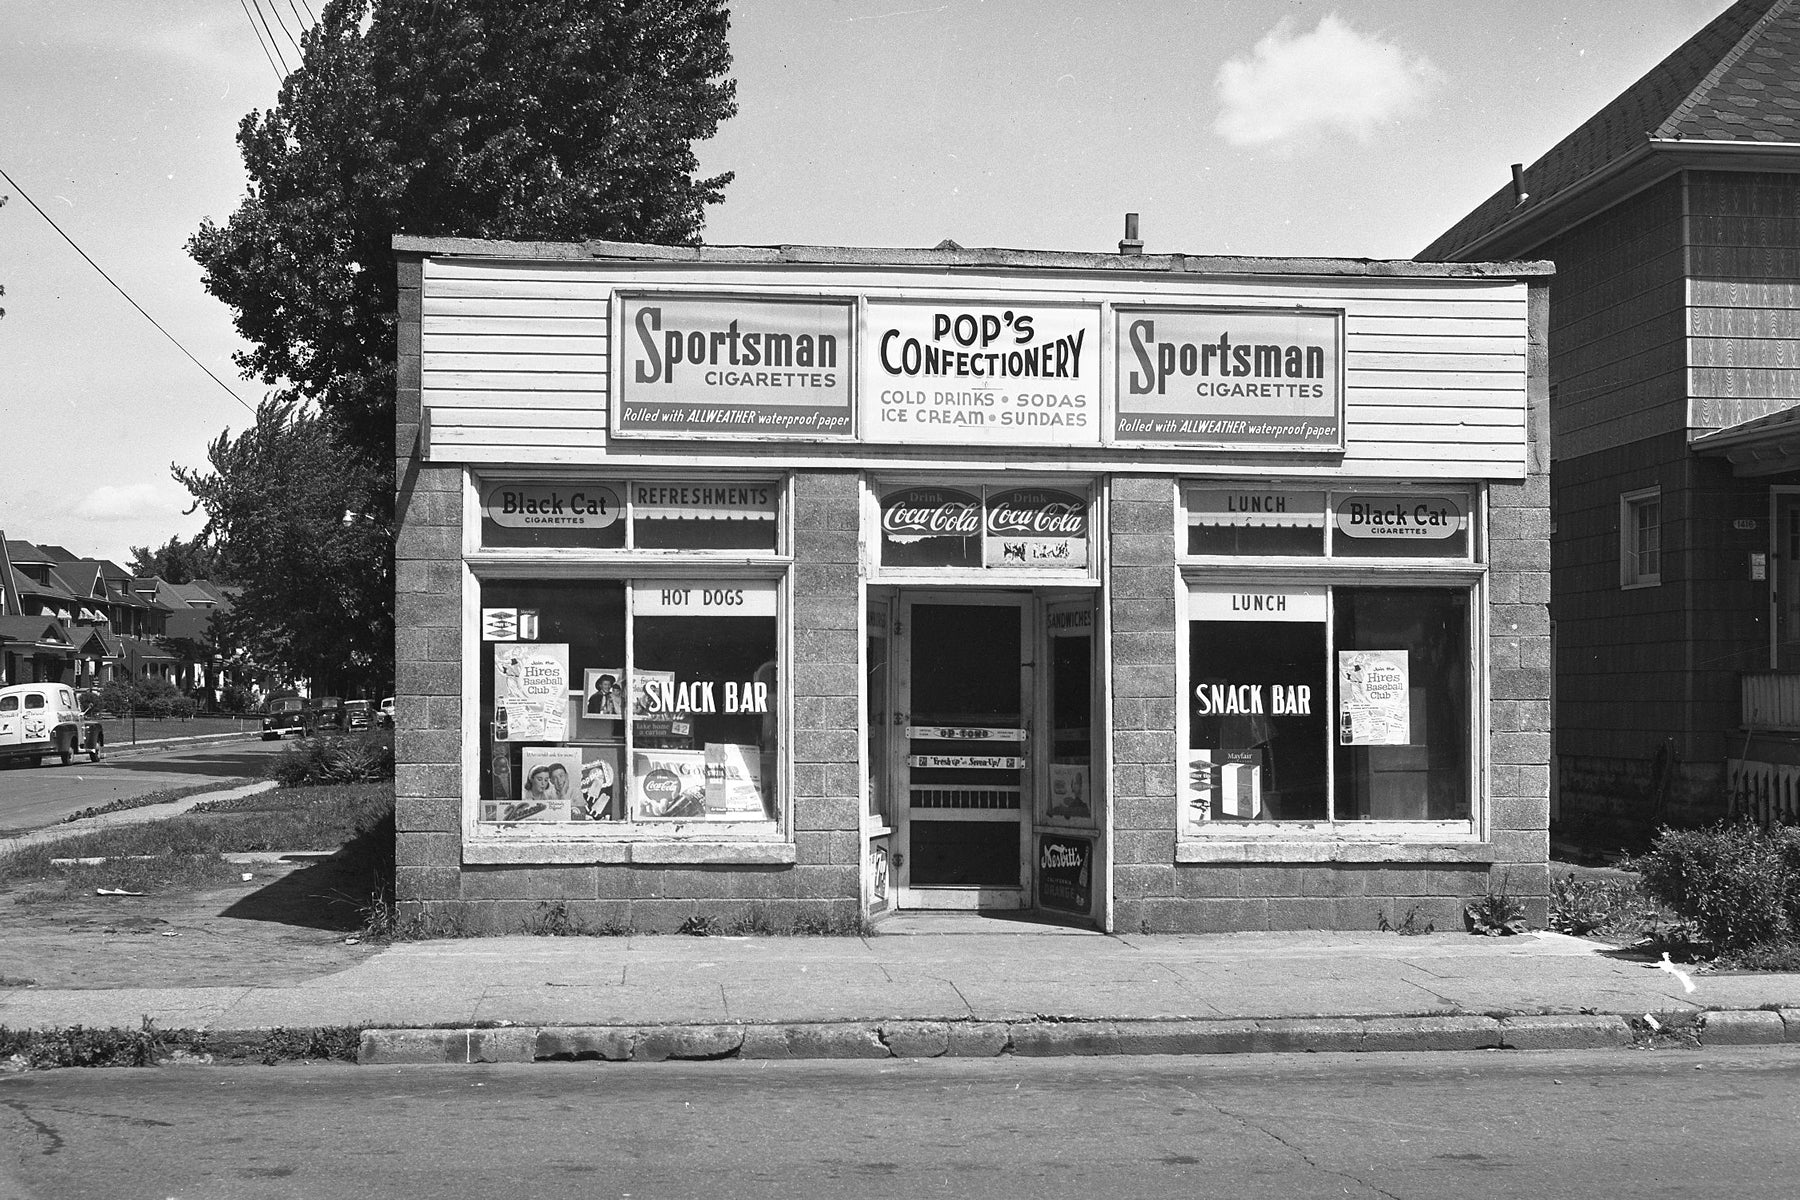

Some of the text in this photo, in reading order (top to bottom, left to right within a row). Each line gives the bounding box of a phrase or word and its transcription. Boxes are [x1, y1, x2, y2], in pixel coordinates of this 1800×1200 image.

[933, 310, 1035, 348] POP'S
[635, 307, 837, 384] Sportsman
[880, 328, 1086, 378] CONFECTIONERY
[1129, 319, 1324, 395] Sportsman
[704, 371, 836, 388] CIGARETTES
[880, 390, 1087, 408] COLD DRINKS SODAS
[1196, 382, 1324, 398] CIGARETTES
[623, 408, 659, 423] Rolled
[661, 409, 685, 423] with
[757, 410, 819, 429] waterproof
[817, 414, 850, 430] paper
[880, 408, 1088, 427] ICE CREAM SUNDAES
[1117, 418, 1153, 433] Rolled
[1155, 419, 1178, 433] with
[1248, 420, 1308, 438] waterproof
[1305, 425, 1337, 440] paper
[502, 491, 607, 516] Black Cat
[637, 487, 769, 505] REFRESHMENTS
[910, 491, 944, 503] Drink
[1013, 492, 1048, 504] Drink
[1227, 495, 1286, 513] LUNCH
[524, 516, 585, 525] CIGARETTES
[883, 500, 984, 532] Coca-Cola
[986, 501, 1089, 532] Coca-Cola
[1349, 502, 1449, 526] Black Cat
[1371, 527, 1428, 535] CIGARETTES
[661, 588, 744, 606] HOT DOGS
[1232, 594, 1287, 611] LUNCH
[1046, 610, 1092, 629] SANDWICHES
[524, 666, 560, 677] Hires
[1367, 672, 1401, 683] Hires
[523, 677, 563, 686] Baseball
[527, 686, 550, 695] Club
[1366, 682, 1404, 692] Baseball
[645, 681, 769, 714] SNACK BAR
[1195, 683, 1312, 715] SNACK BAR
[1370, 691, 1392, 700] Club
[674, 724, 688, 734] 42
[1227, 752, 1253, 763] Mayfair
[1041, 844, 1084, 870] Nesbitt's
